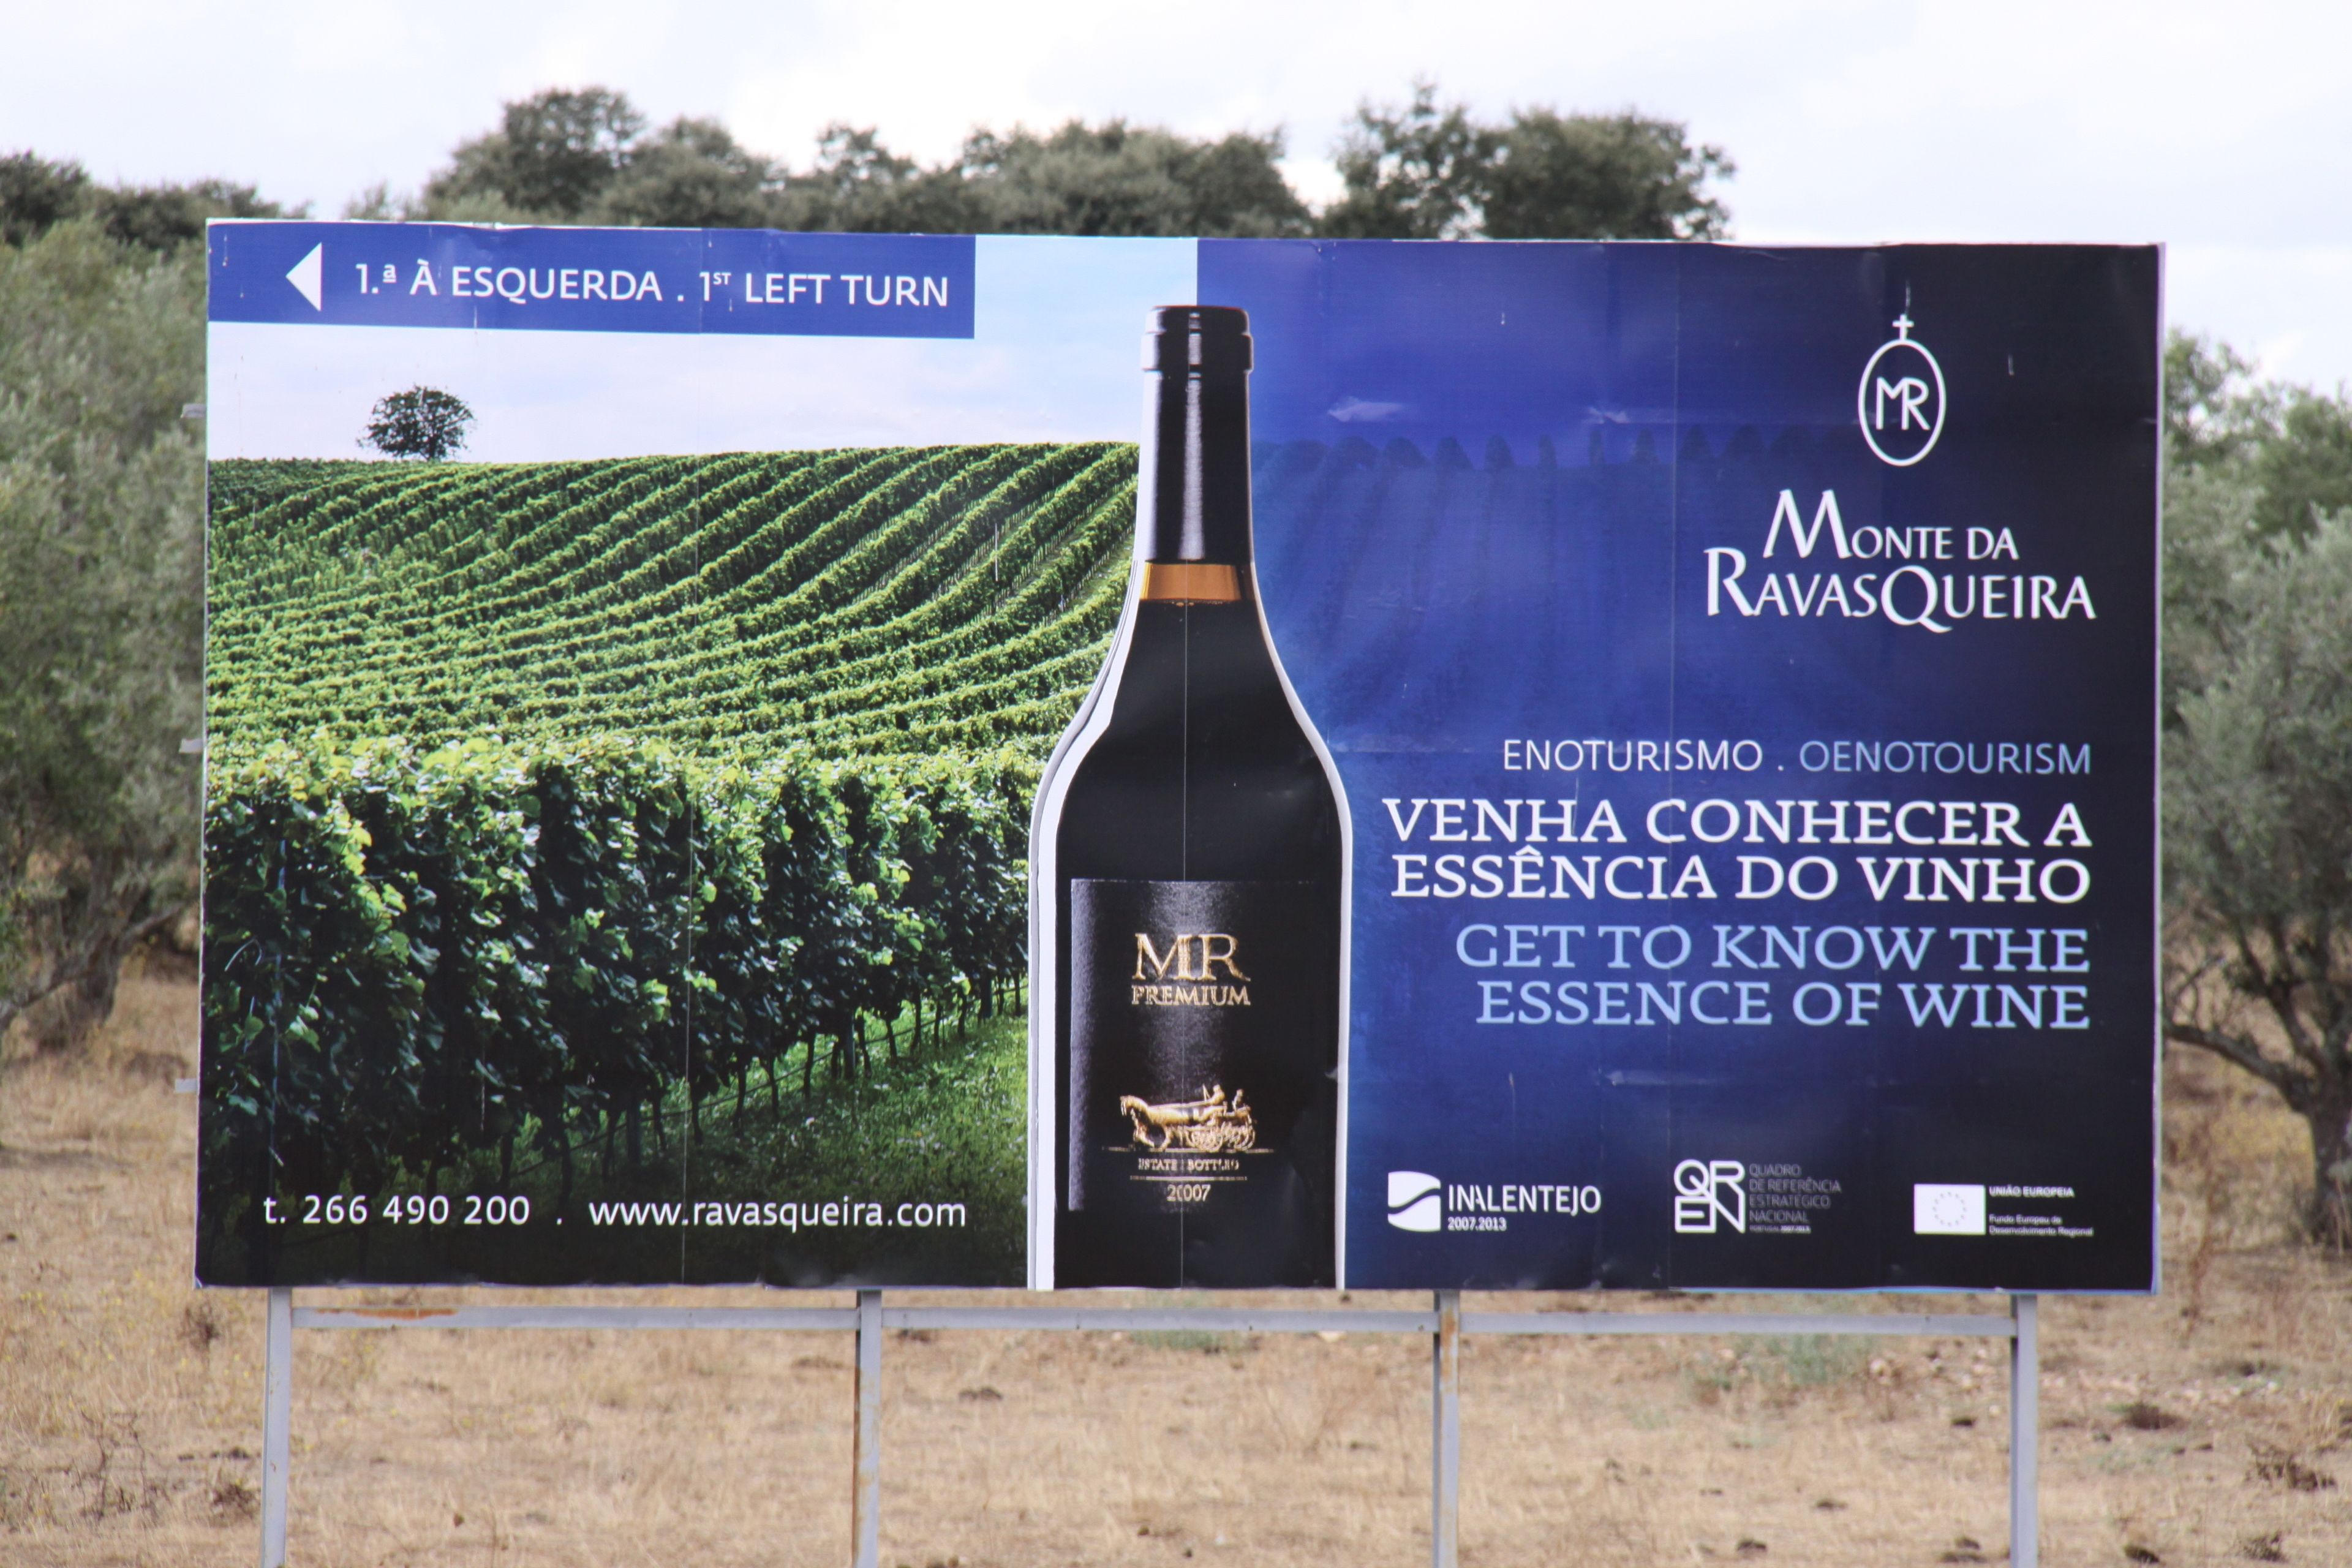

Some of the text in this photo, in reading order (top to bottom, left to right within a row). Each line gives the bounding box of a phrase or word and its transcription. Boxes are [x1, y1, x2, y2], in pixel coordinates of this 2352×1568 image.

[410, 259, 437, 295] À
[453, 266, 662, 304] ESQUERDA
[699, 272, 731, 301] 1ST
[746, 273, 831, 304] LEFT
[840, 275, 948, 306] TURN
[1875, 377, 1930, 430] MR
[1763, 489, 2019, 560] MONTE DA
[1504, 740, 1762, 771] ENOTURISMO
[1800, 741, 2090, 774] OENOTOURISM
[1382, 799, 2092, 847] VENHA CONHECER A
[1391, 845, 2091, 903] ESSÊNCIA DO VINHO
[1132, 933, 1251, 982] MR
[1456, 924, 2090, 973] GET TO KNOW THE
[1131, 985, 1251, 1006] PREMIUM
[1477, 981, 2090, 1029] ESSENCE OF WINE
[1749, 1163, 1801, 1177] QUADRO
[1749, 1179, 1764, 1192] DE
[1989, 1185, 2075, 1197] UNIÃO EUROPEIA
[264, 1197, 285, 1224] t.
[303, 1196, 367, 1224] 266
[383, 1196, 448, 1224] 490
[464, 1196, 529, 1225] 200
[589, 1196, 966, 1234] www.ravasqueira.com
[1447, 1217, 1507, 1231] 2007.2013
[1749, 1210, 1809, 1223] NACIONAL
